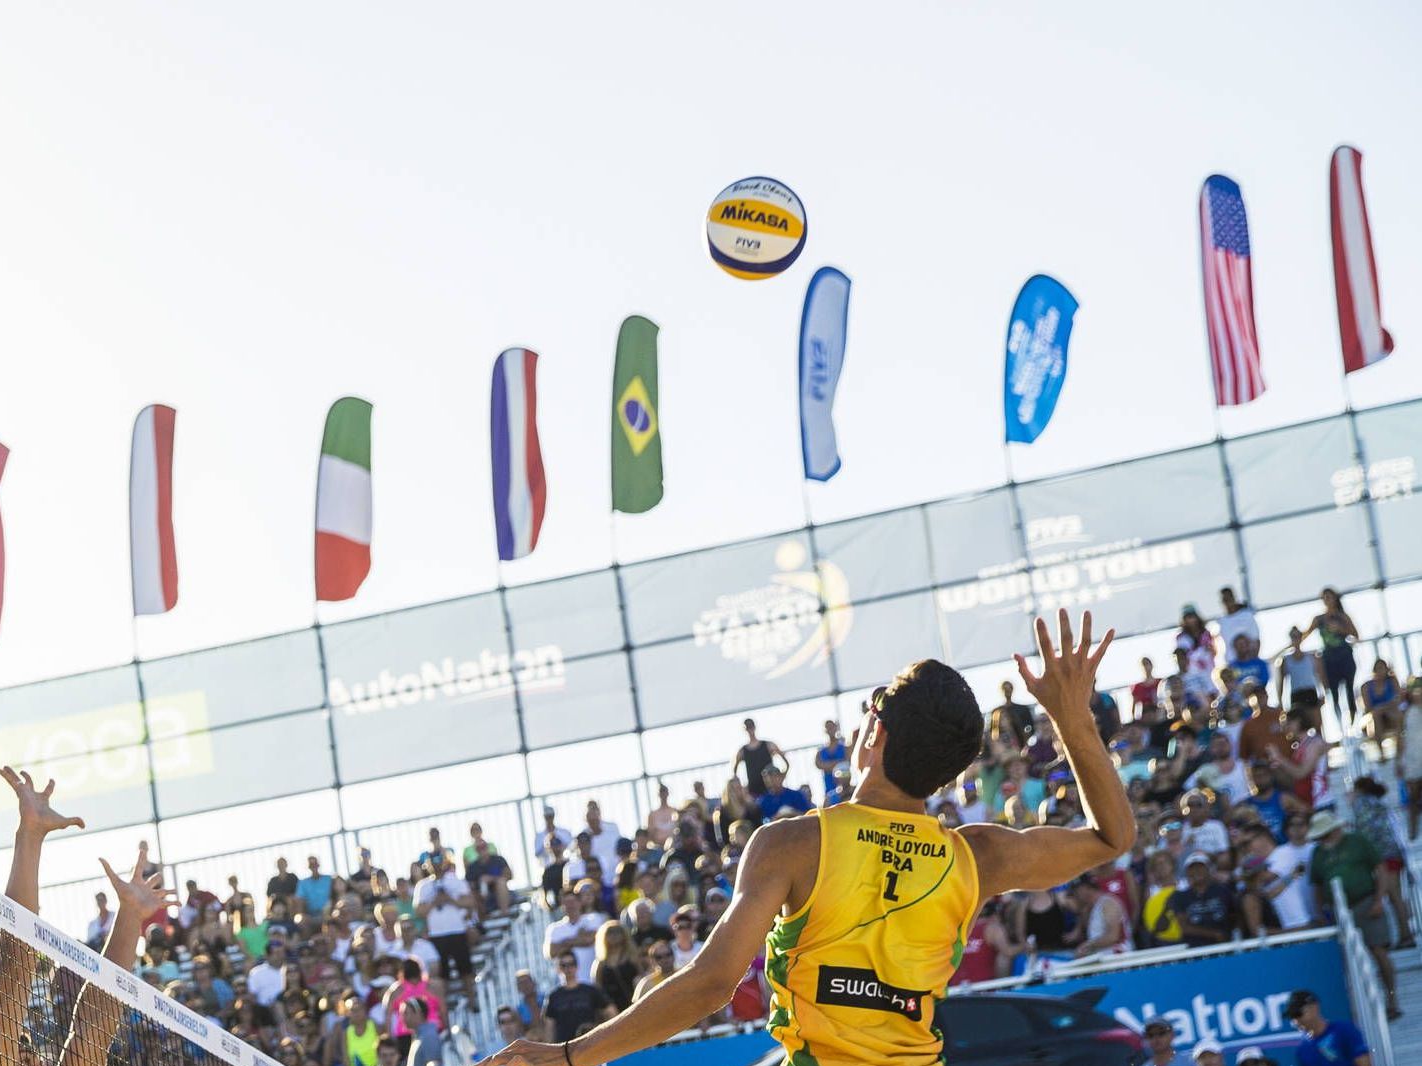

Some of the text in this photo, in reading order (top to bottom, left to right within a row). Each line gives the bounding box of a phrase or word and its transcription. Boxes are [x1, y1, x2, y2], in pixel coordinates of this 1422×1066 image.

[889, 822, 916, 834] FIVB
[857, 829, 947, 858] ANDRE LOYOLA
[881, 850, 914, 872] BRA
[883, 871, 899, 903] 1
